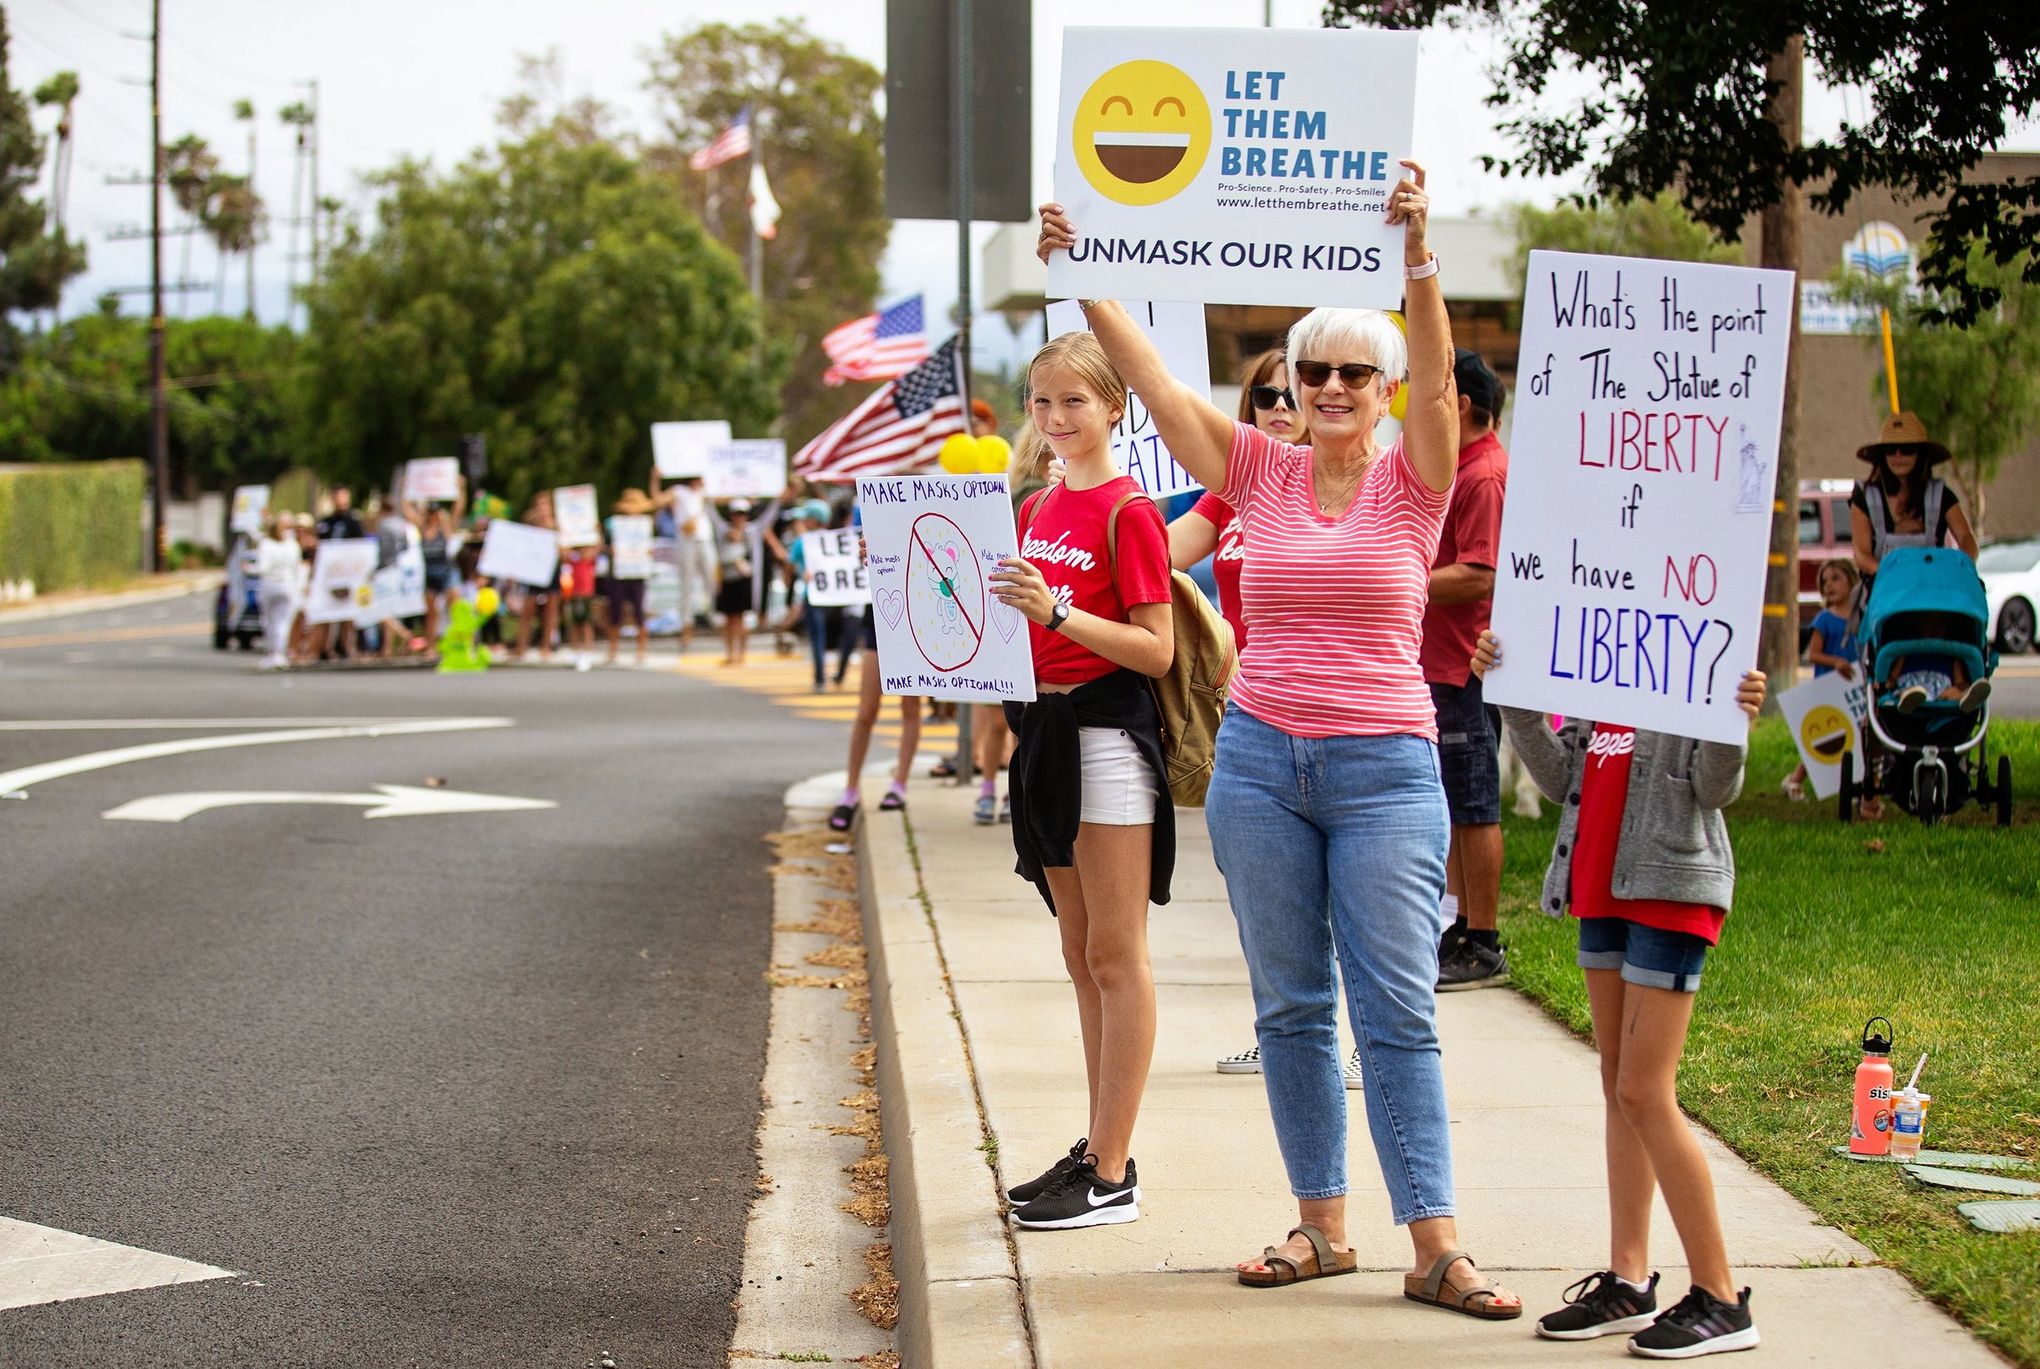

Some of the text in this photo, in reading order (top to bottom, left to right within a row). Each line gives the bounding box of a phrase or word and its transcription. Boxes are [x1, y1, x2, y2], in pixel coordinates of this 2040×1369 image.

[1226, 70, 1286, 101] LET
[1223, 108, 1327, 140] THEM
[1221, 146, 1388, 180] BREATHE
[1216, 197, 1386, 213] www.letthembreathe.net
[1217, 182, 1386, 197] Pro-Science Pro-Safety Pro-Smiles
[1068, 237, 1382, 272] UNMASK OUR KIDS
[1660, 276, 1699, 332] the
[1712, 283, 1767, 353] point
[1530, 348, 1756, 402] of The Statue of
[1579, 410, 1729, 481] LIBERTY
[862, 481, 907, 504] MAKE
[913, 480, 959, 501] MASKS
[1621, 483, 1643, 529] if
[1571, 538, 1635, 590] have
[1663, 554, 1717, 606] NO
[1550, 605, 1733, 704] LIBERTY?
[886, 675, 912, 690] MAKE
[918, 674, 947, 688] MASKS
